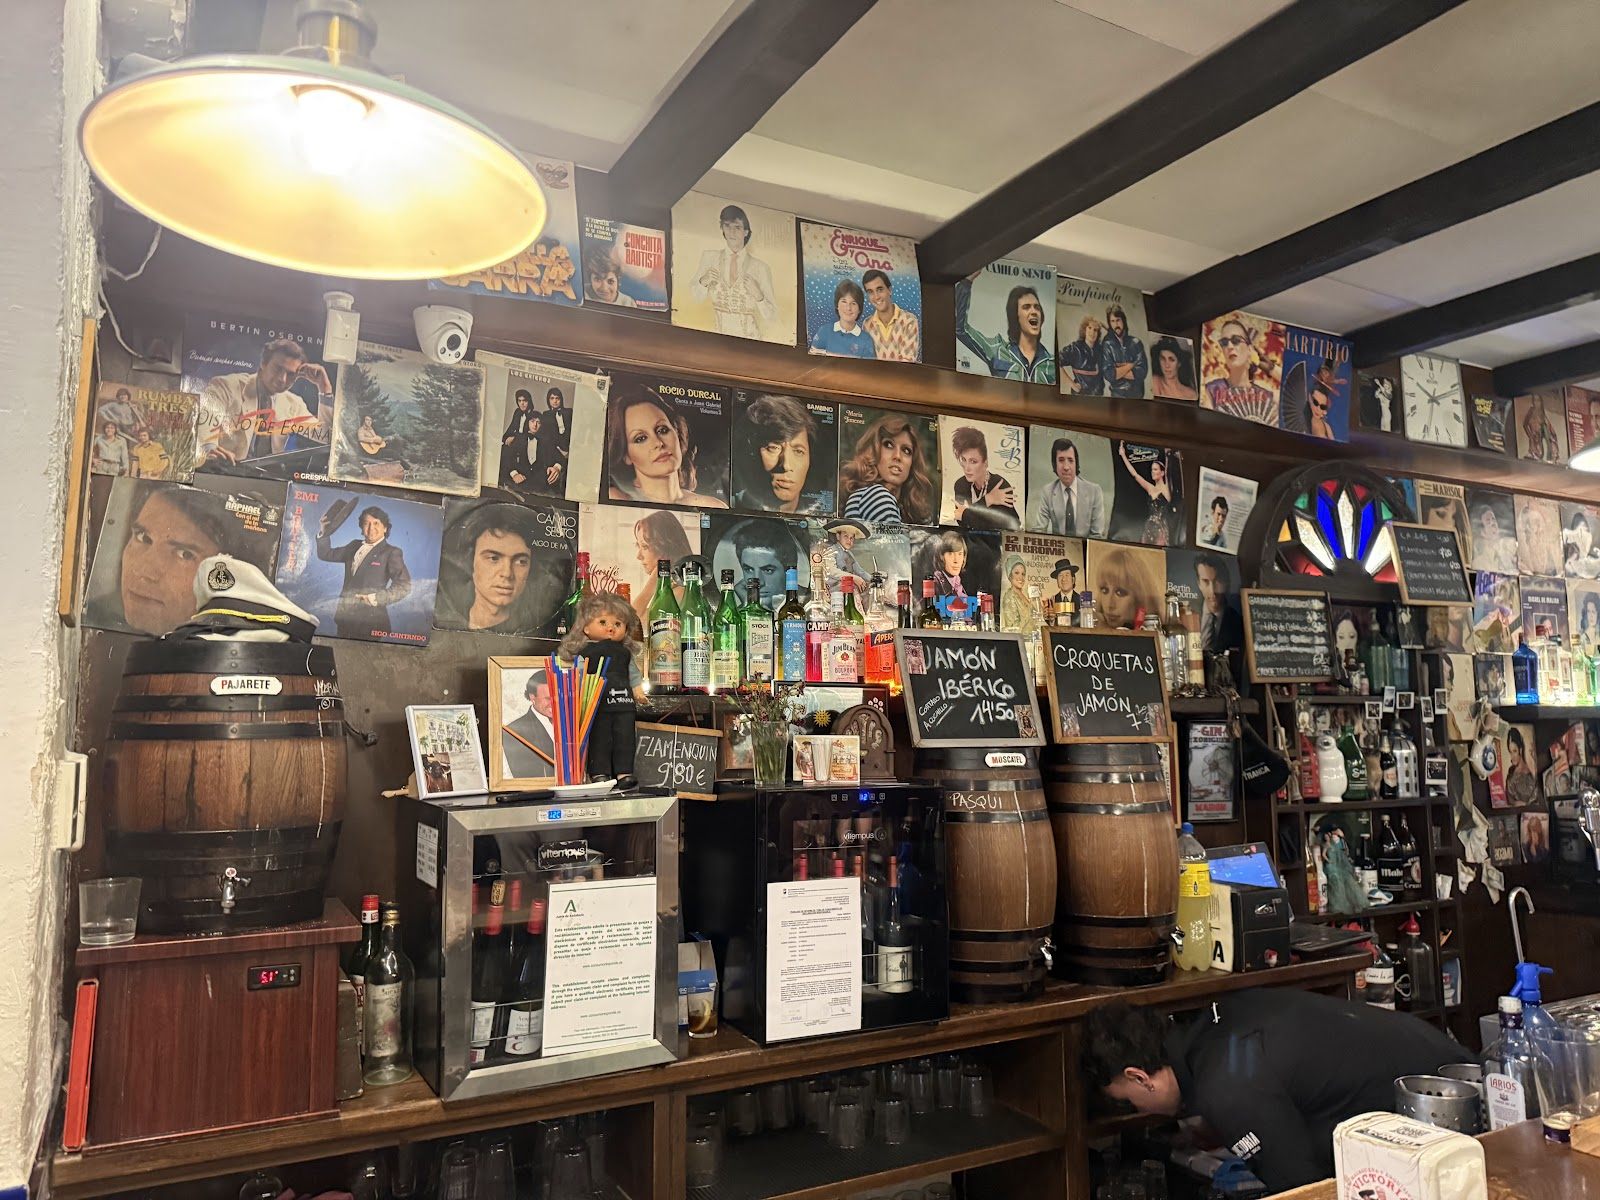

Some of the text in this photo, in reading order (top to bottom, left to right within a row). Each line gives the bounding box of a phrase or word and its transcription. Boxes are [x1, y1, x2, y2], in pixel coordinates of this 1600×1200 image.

[626, 232, 662, 253] CONCHITA
[986, 263, 1052, 280] CAMILO SESTO
[1058, 281, 1122, 304] Pimpinela
[210, 321, 323, 345] BERTIN OSBORN
[137, 389, 194, 405] RUMBA
[659, 385, 722, 400] ROCIO DURCAL
[149, 402, 189, 414] TRES
[294, 492, 319, 502] EMI
[1433, 484, 1462, 499] MARISOL
[225, 501, 261, 514] RAPHAEL
[532, 538, 550, 548] ALGO
[550, 541, 559, 549] DE
[1006, 535, 1065, 548] 12 PELEAS
[1004, 543, 1065, 556] EN BROMA
[807, 621, 833, 632] CAMP
[924, 646, 997, 672] JAMÓN
[1054, 644, 1154, 674] CROQUETAS
[222, 680, 271, 690] PAJARETE
[938, 672, 1016, 700] IBÉRICO
[1092, 676, 1115, 691] DE
[1077, 692, 1130, 718] JAMÓN
[1201, 726, 1222, 736] GIN
[637, 736, 717, 762] FLAMENQUIN
[992, 756, 1023, 764] MOSCATEL
[1243, 765, 1270, 780] TRANCA
[952, 792, 1002, 810] PASQUI
[541, 847, 585, 860] vitempus
[1490, 1077, 1517, 1091] LARIOS
[1352, 1173, 1408, 1200] VICTORI
